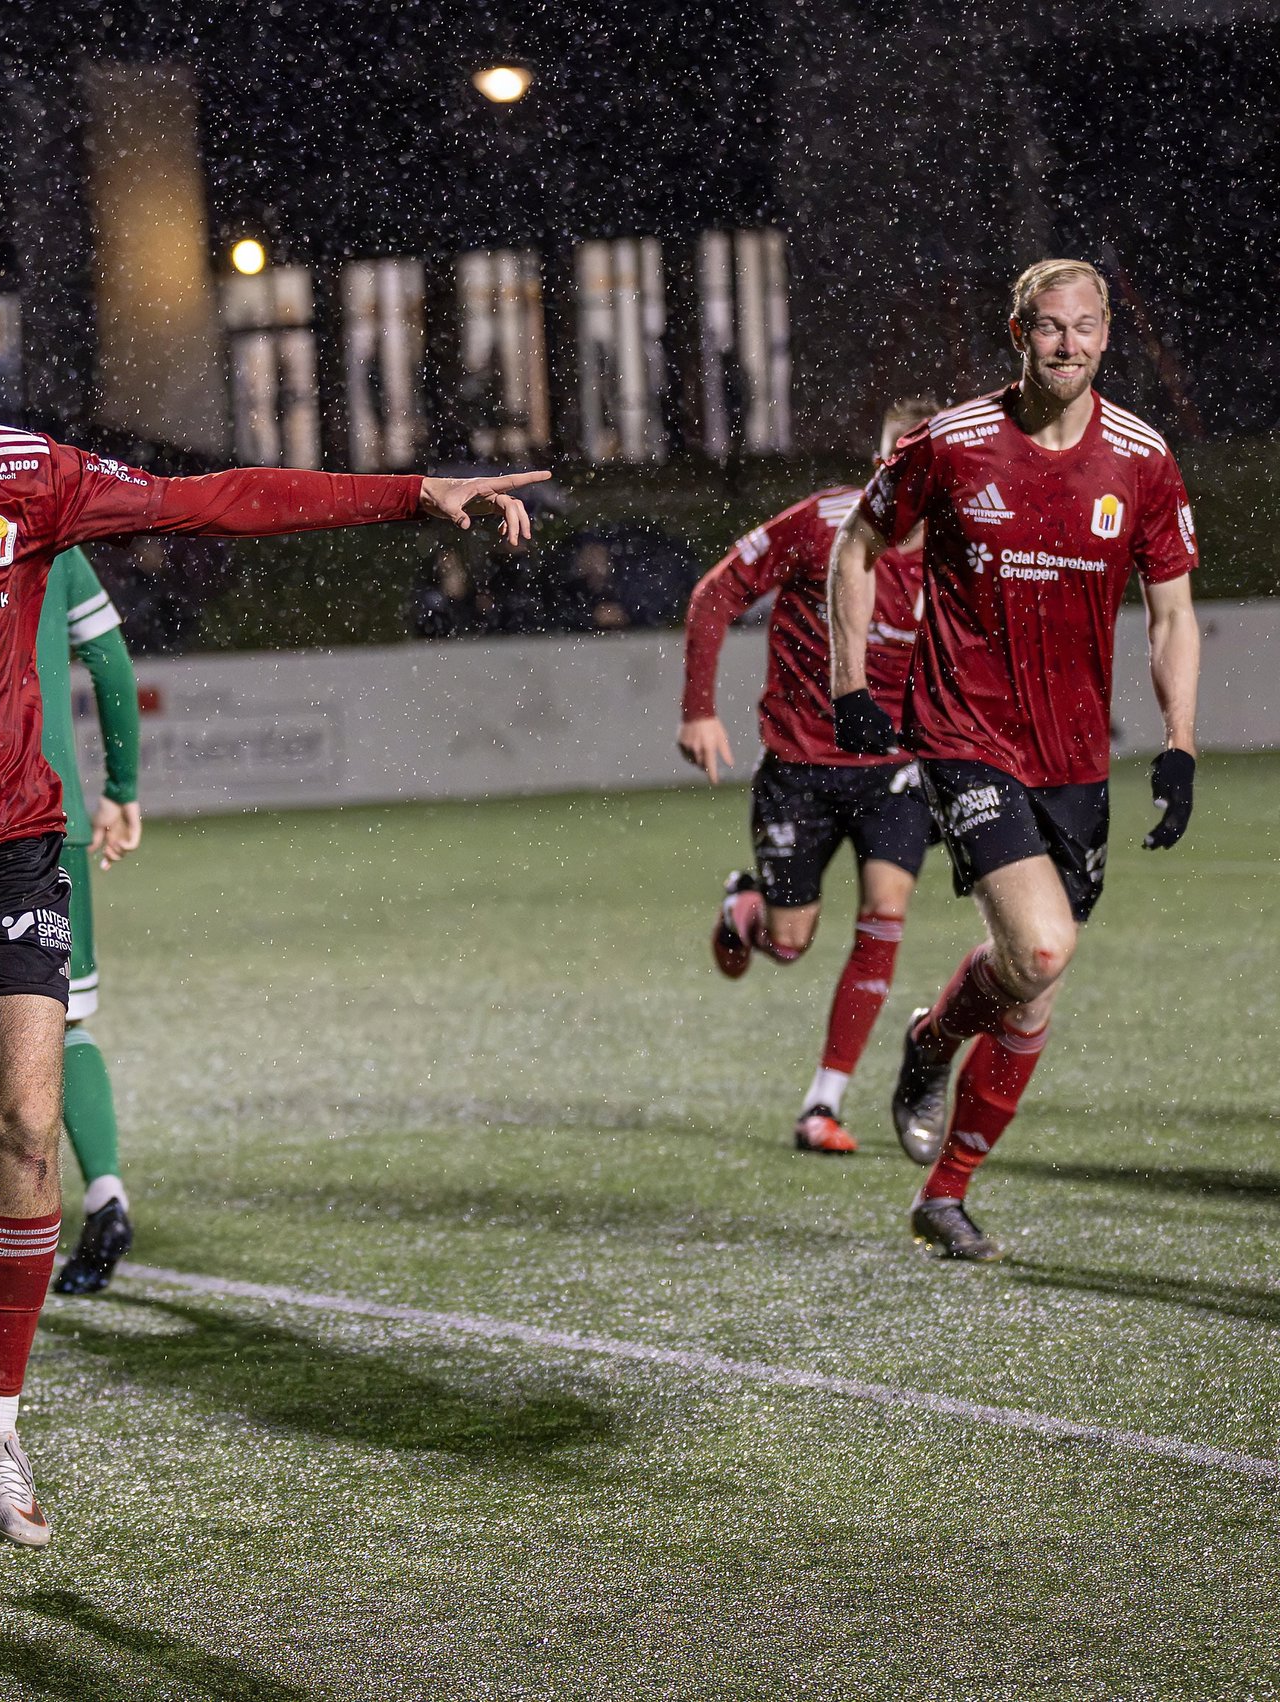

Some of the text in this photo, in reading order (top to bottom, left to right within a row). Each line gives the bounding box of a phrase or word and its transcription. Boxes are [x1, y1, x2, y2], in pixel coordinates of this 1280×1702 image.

[8, 459, 39, 472] 1000
[1000, 549, 1107, 573] Odal Sparebank
[1000, 564, 1060, 582] Gruppen
[35, 908, 71, 931] INTER
[37, 922, 72, 944] SPORT
